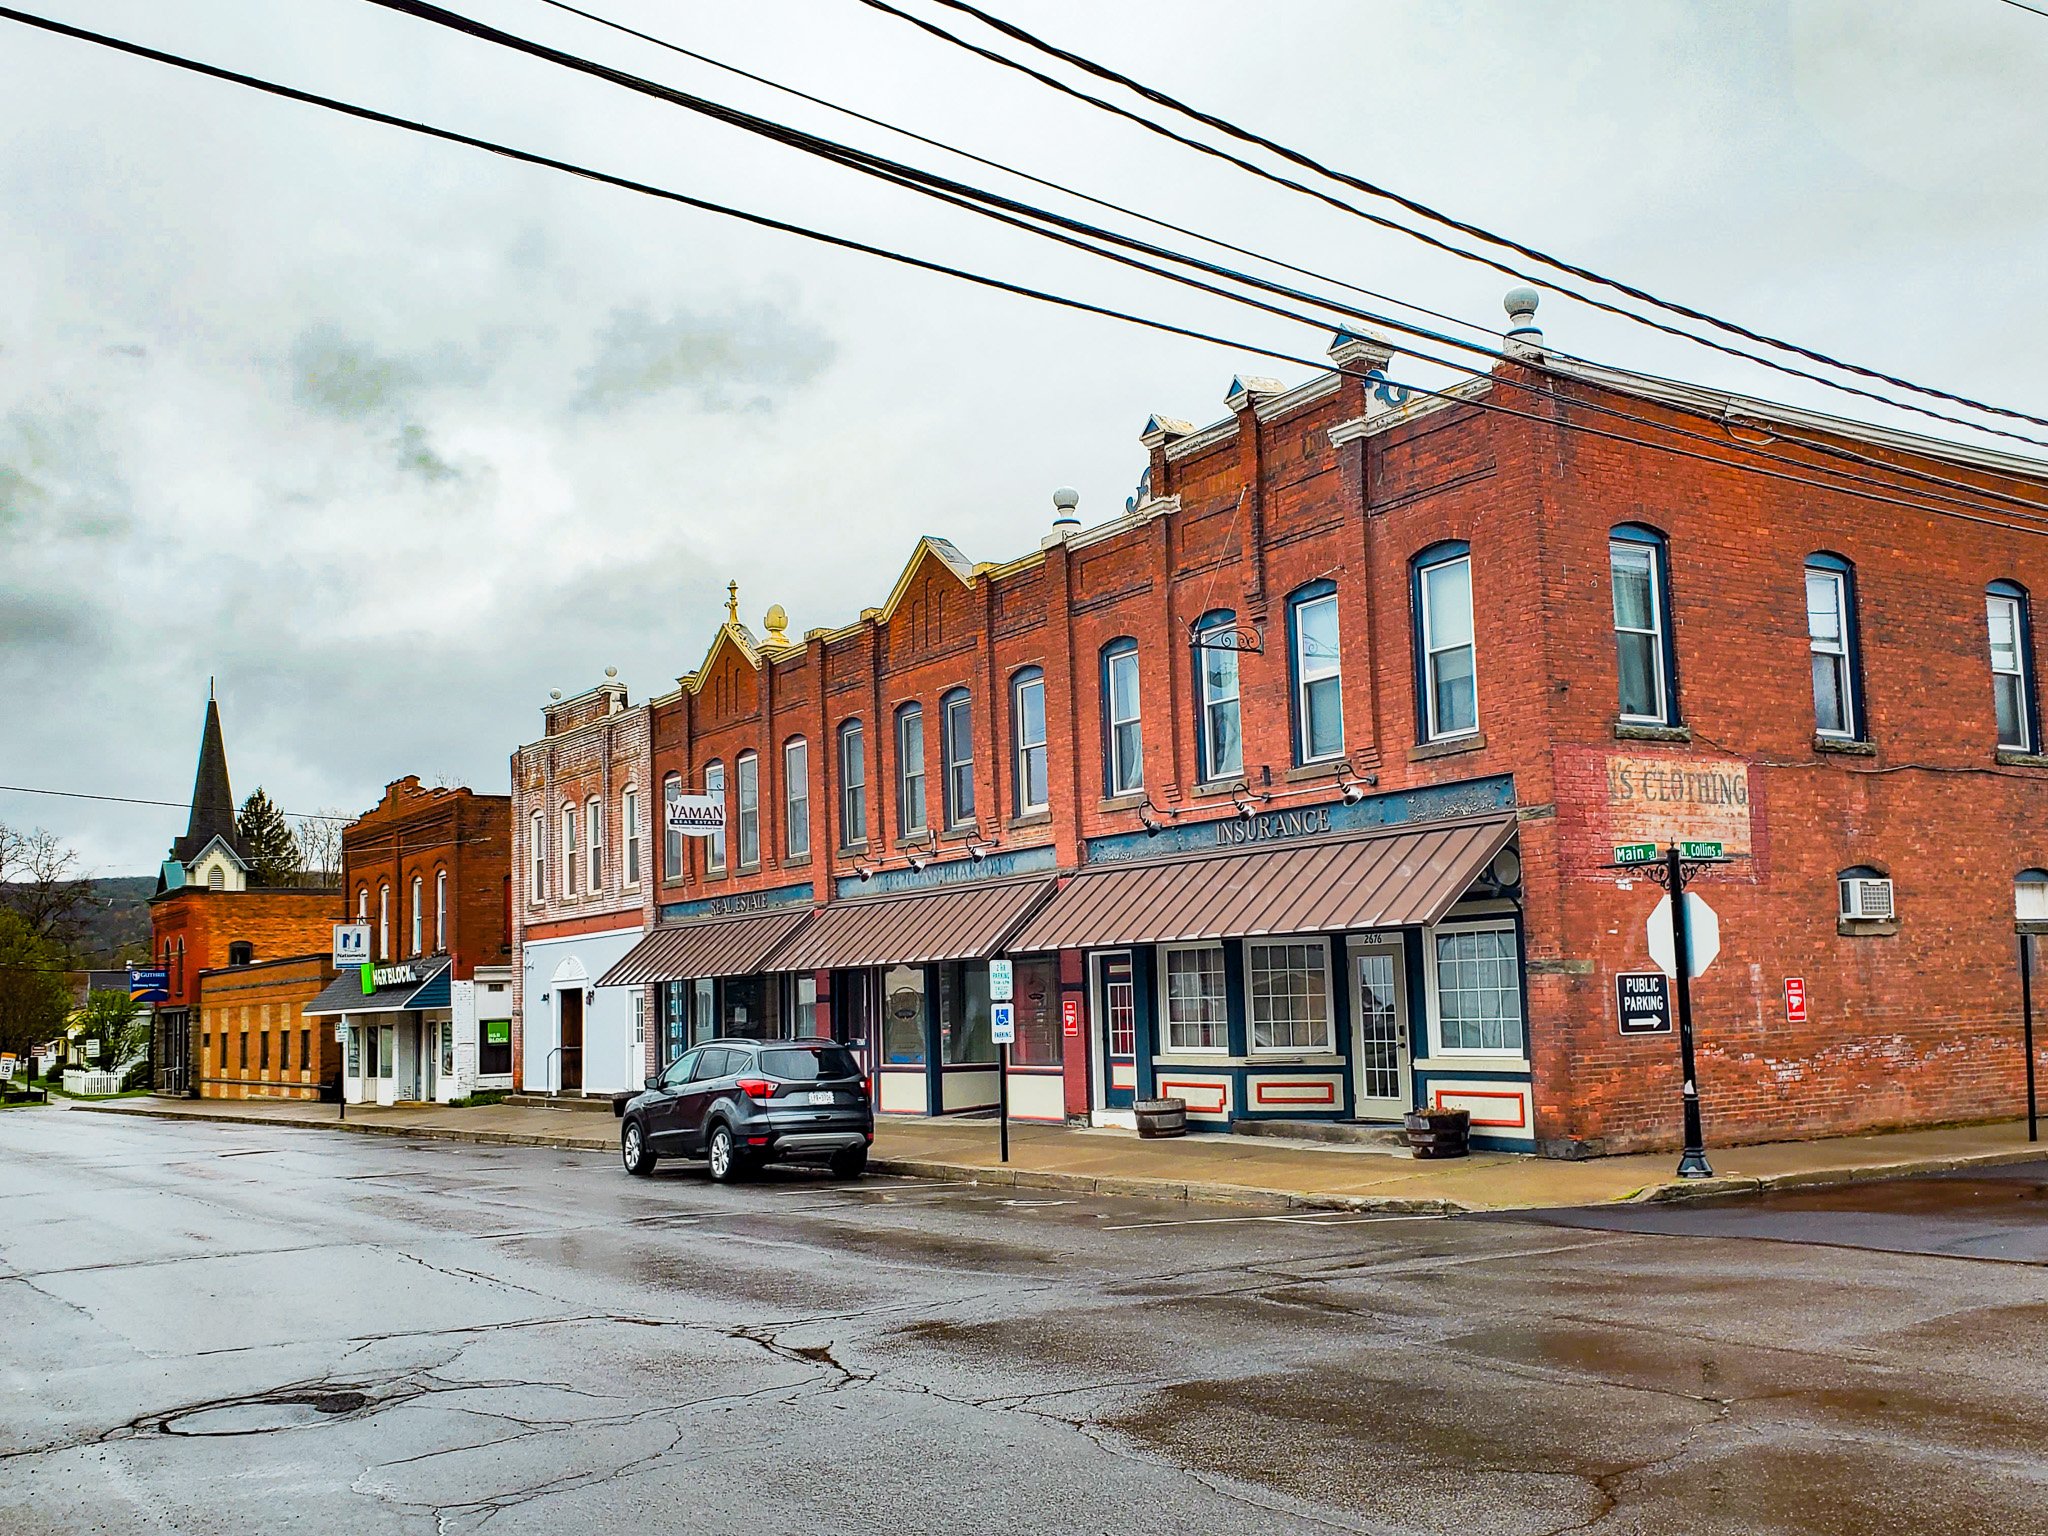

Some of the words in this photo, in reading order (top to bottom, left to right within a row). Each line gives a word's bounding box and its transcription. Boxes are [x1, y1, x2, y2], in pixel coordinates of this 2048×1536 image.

[1642, 768, 1747, 805] CLOTHING
[669, 803, 723, 819] YAMAN
[1216, 809, 1332, 846] INSURANCE
[1616, 846, 1643, 862] Main
[1690, 843, 1716, 858] Collins
[711, 898, 733, 916] REAL
[735, 893, 768, 912] ESTATE
[1364, 934, 1382, 944] 2676
[387, 964, 412, 984] BLOCK
[1626, 978, 1659, 992] PUBLIC
[1624, 996, 1664, 1012] PARKING
